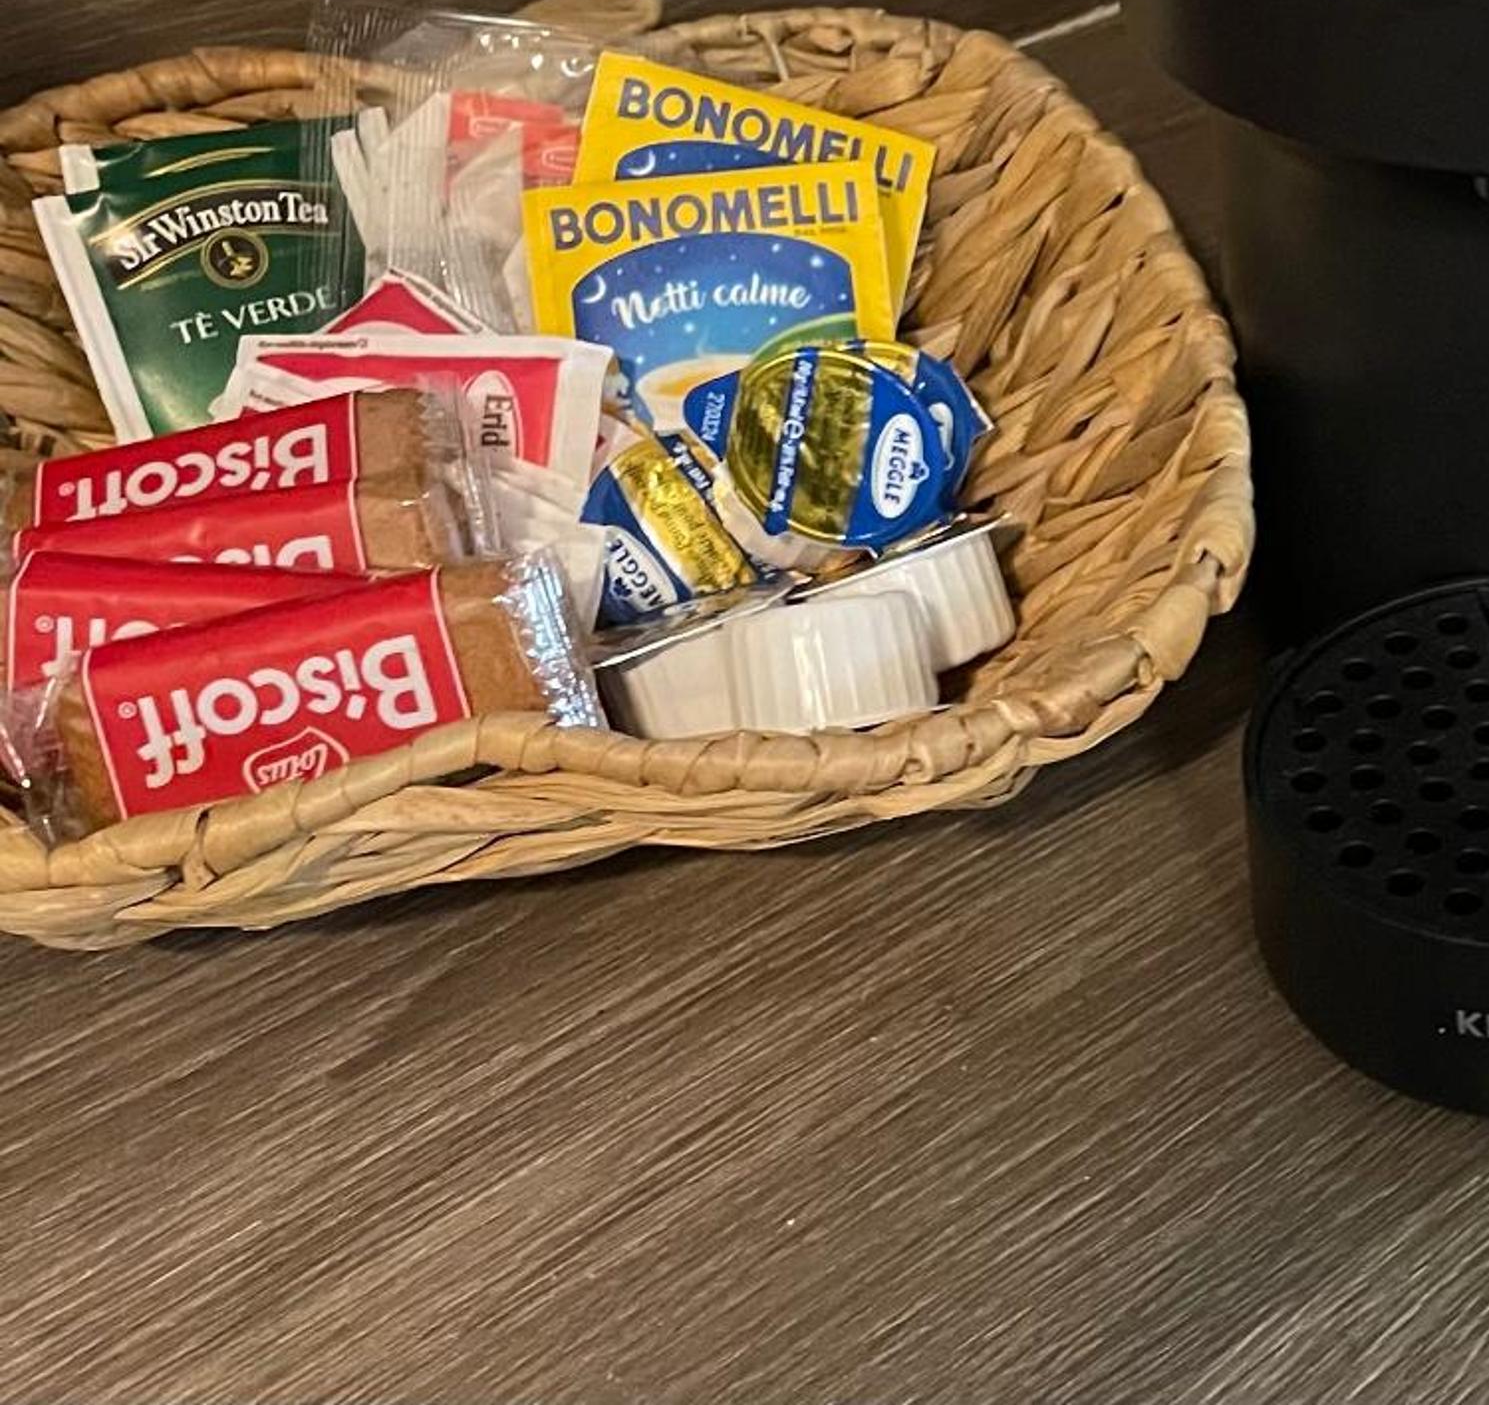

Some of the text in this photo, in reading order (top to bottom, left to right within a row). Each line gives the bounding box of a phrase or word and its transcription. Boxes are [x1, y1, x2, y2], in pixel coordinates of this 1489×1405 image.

[550, 181, 860, 251] BONOMELLI
[170, 310, 219, 345] TÈ
[611, 271, 812, 330] Notti calme
[481, 395, 514, 448] Erid
[884, 428, 913, 505] MEGGLE
[136, 634, 437, 788] Biscoff
[257, 743, 329, 786] Lotus
